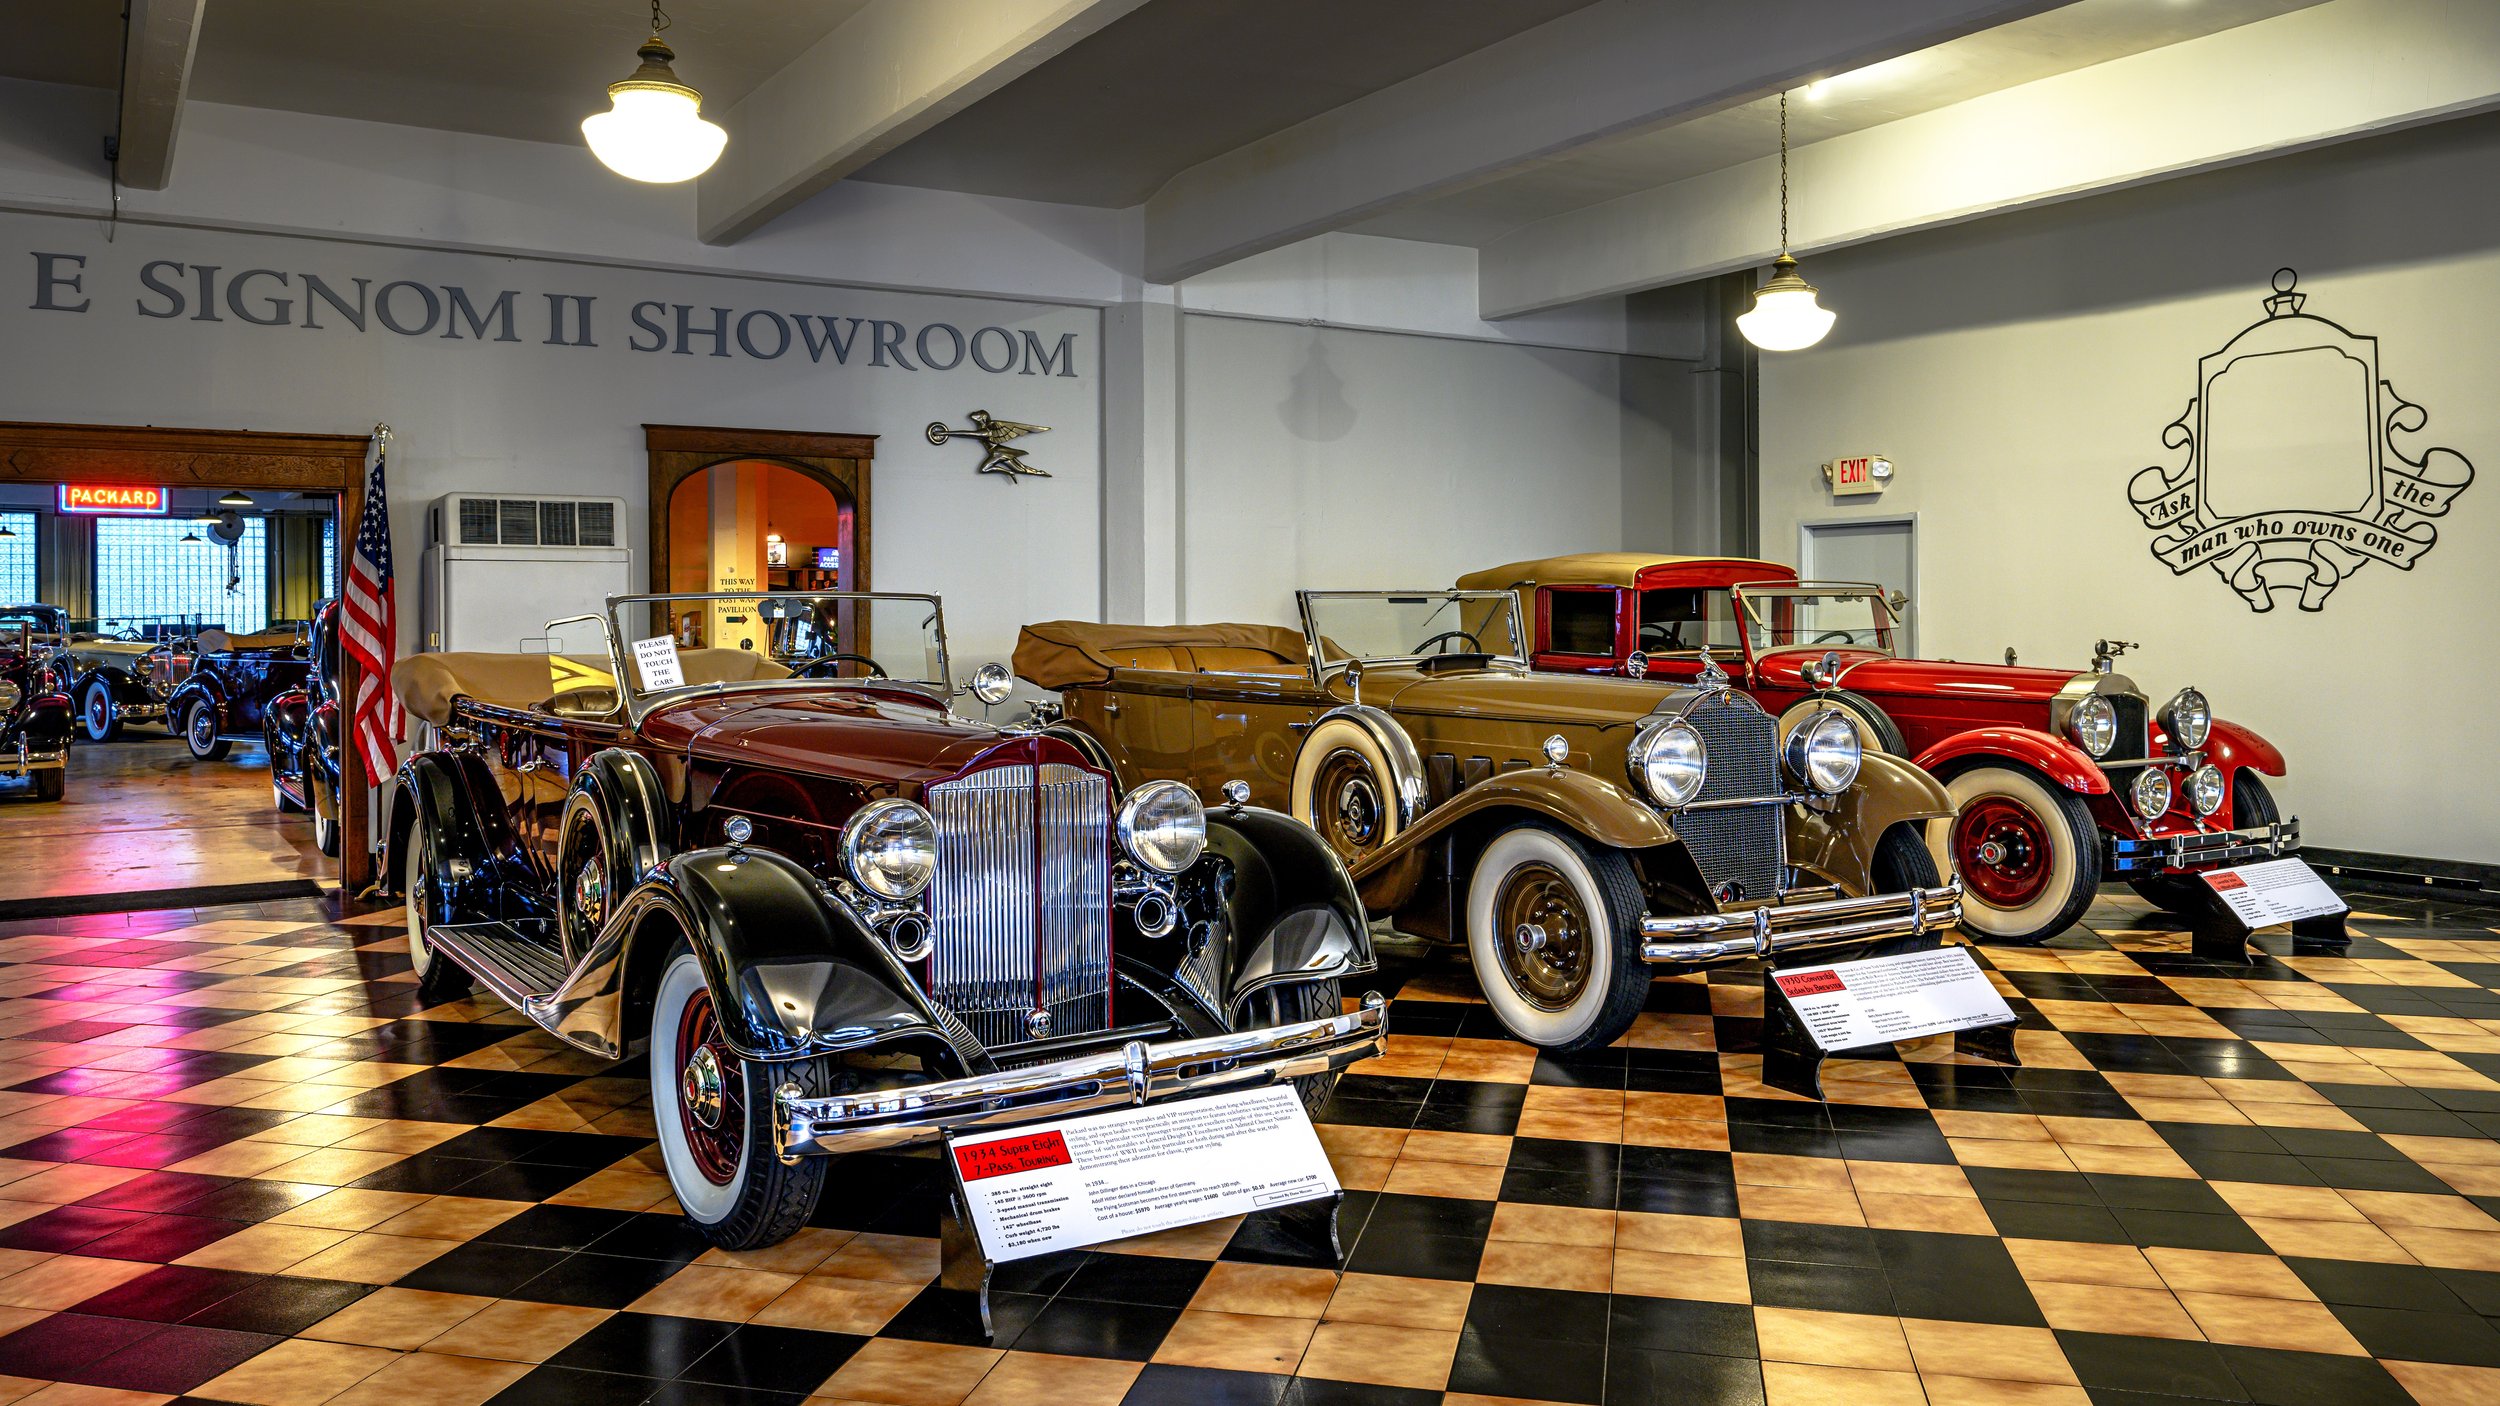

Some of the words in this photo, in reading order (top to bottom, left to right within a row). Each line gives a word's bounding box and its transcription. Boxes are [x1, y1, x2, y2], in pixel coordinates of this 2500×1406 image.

[28, 251, 91, 313] E
[135, 260, 522, 343] SIGNOM
[542, 293, 598, 347] II
[629, 300, 1079, 378] SHOWROOM
[1840, 458, 1868, 483] EXIT
[70, 487, 157, 506] PACKARD
[2150, 492, 2191, 522] Ask
[2392, 479, 2436, 508] the
[2180, 527, 2228, 564] man
[2234, 519, 2283, 538] who
[2292, 521, 2358, 542] owns
[2363, 532, 2405, 559] one
[638, 639, 669, 650] PLEASE
[640, 651, 652, 659] DO
[654, 648, 672, 657] NOT
[644, 658, 673, 669] TOUCH
[651, 669, 670, 677] THE
[654, 678, 674, 687] CARS
[1781, 977, 1800, 985] 1930
[1066, 1127, 1087, 1135] Packard
[1136, 1116, 1155, 1125] parades
[1227, 1103, 1239, 1111] long
[1104, 1135, 1130, 1145] particular
[1146, 1129, 1171, 1138] passenger
[1145, 1135, 1167, 1143] General
[1162, 1140, 1186, 1150] particular
[963, 1148, 996, 1162] 1934
[1079, 1161, 1118, 1171] demonstrating
[1184, 1145, 1204, 1153] pre-war
[1118, 1191, 1137, 1199] declared
[1140, 1196, 1160, 1204] becomes
[1037, 1197, 1069, 1205] transmission
[1135, 1206, 1150, 1214] $5970
[999, 1212, 1028, 1221] Mechanical
